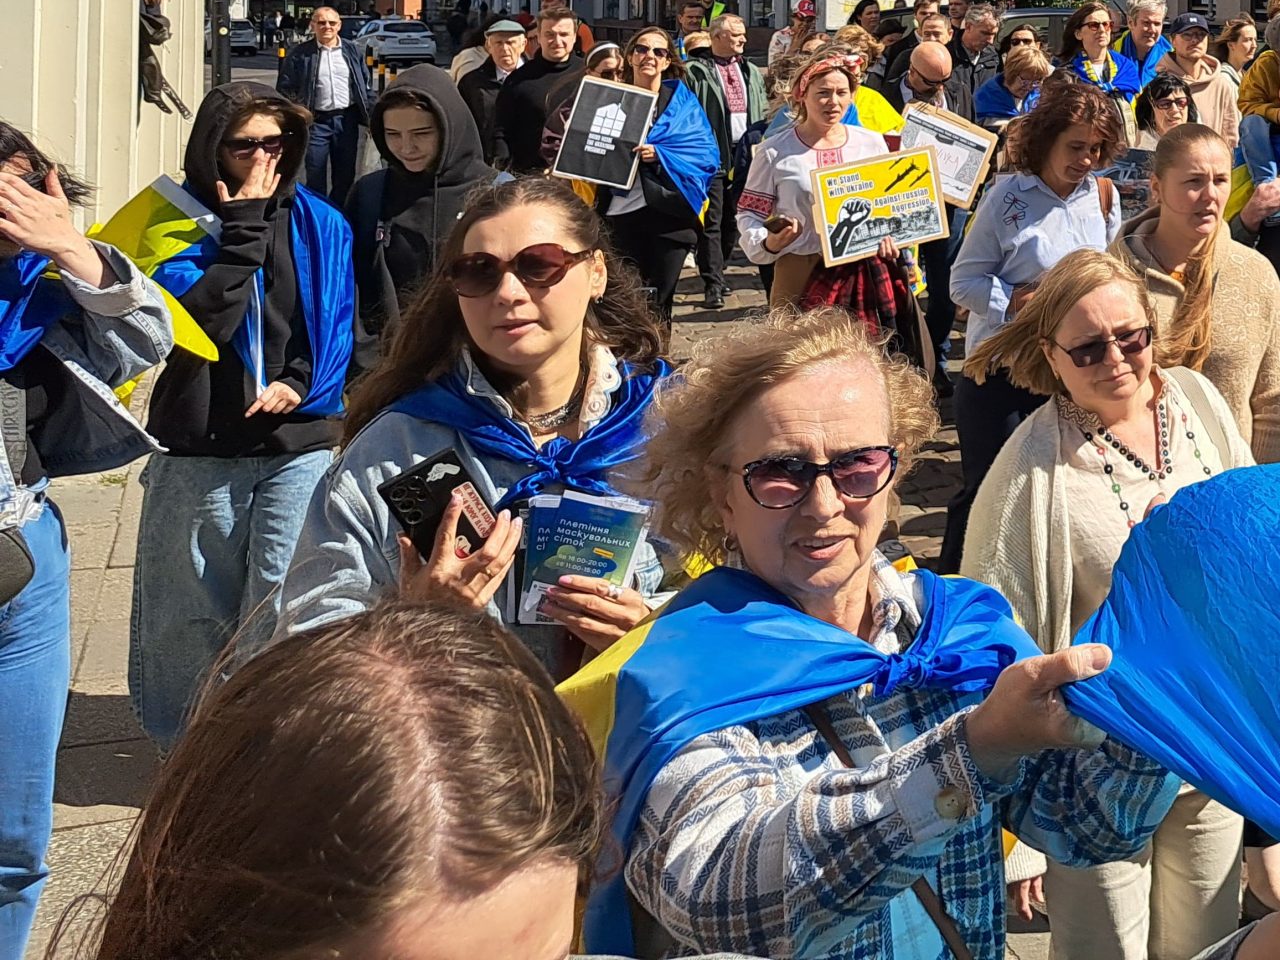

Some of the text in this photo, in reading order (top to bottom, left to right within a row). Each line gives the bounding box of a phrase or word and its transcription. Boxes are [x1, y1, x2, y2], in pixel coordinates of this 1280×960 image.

[560, 518, 610, 534] плетіння
[554, 534, 585, 548] сіток
[557, 526, 631, 548] маскувальних
